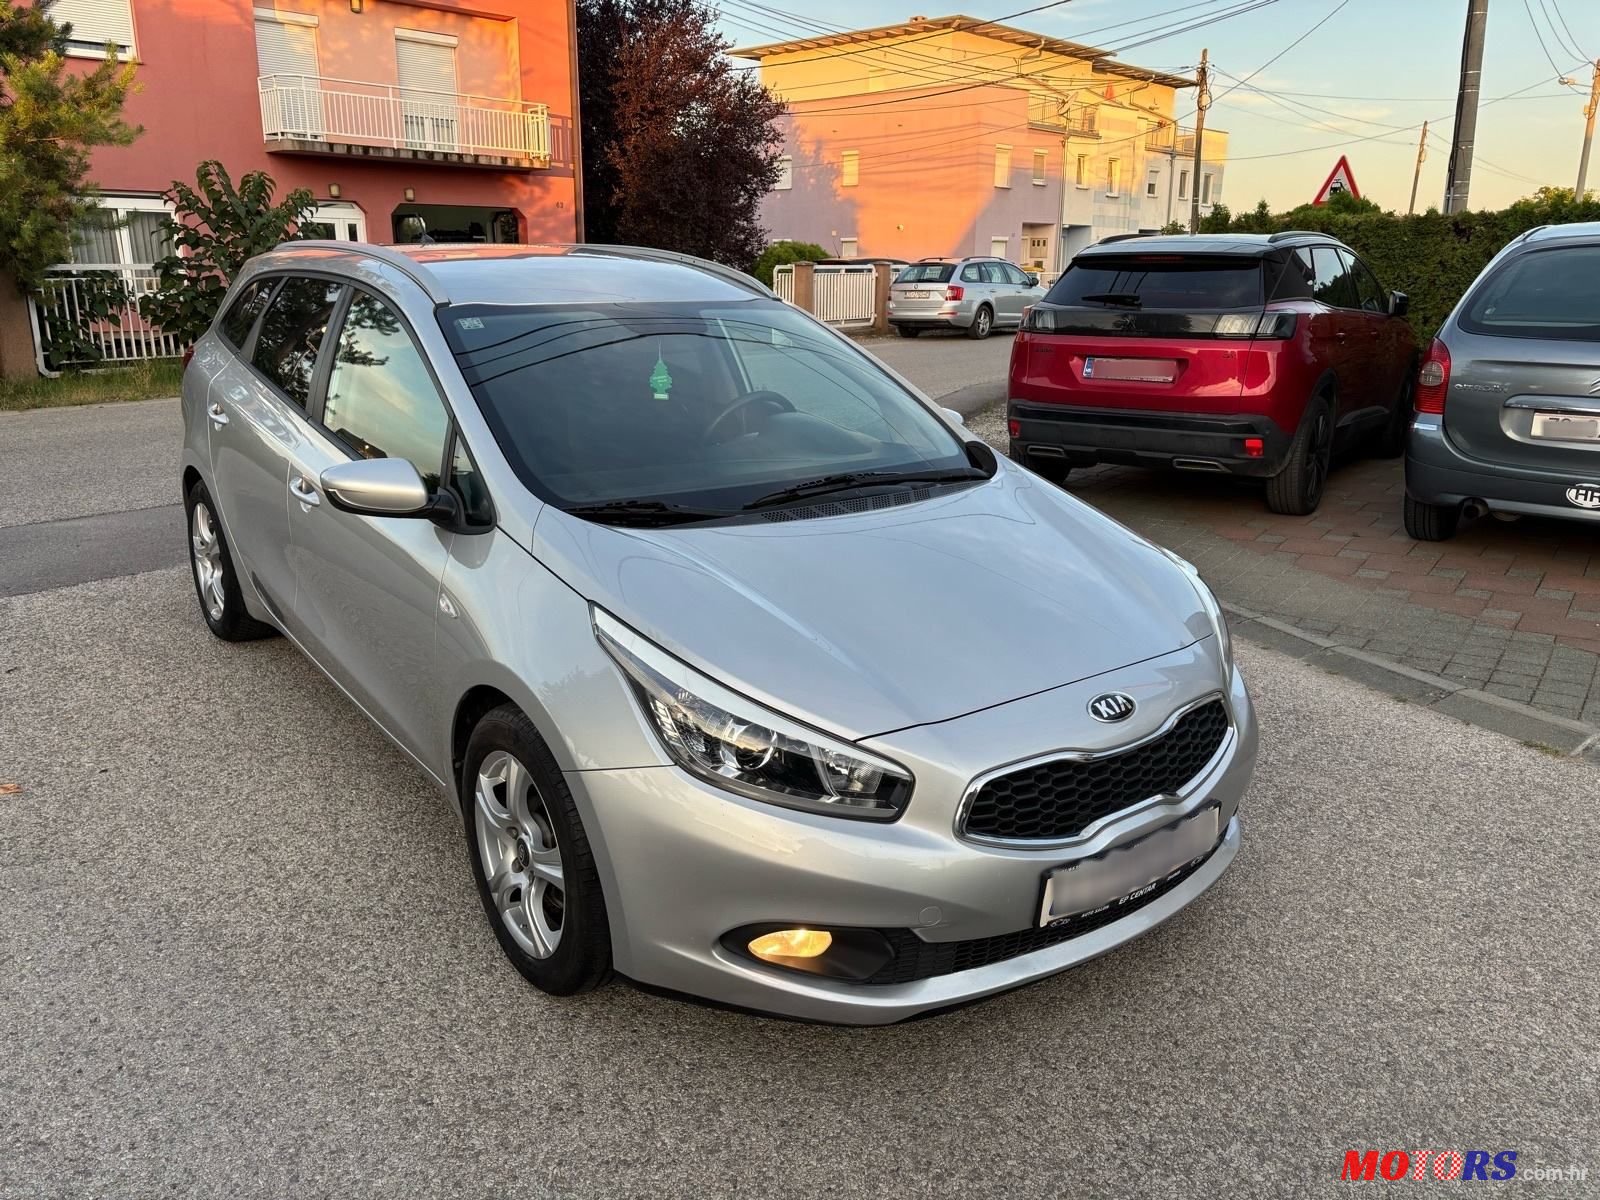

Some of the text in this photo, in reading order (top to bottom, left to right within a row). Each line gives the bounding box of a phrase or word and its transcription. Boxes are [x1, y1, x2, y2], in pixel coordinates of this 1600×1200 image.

[1094, 695, 1132, 718] KIA
[1119, 896, 1129, 904] EP
[1130, 883, 1156, 900] CENTAR
